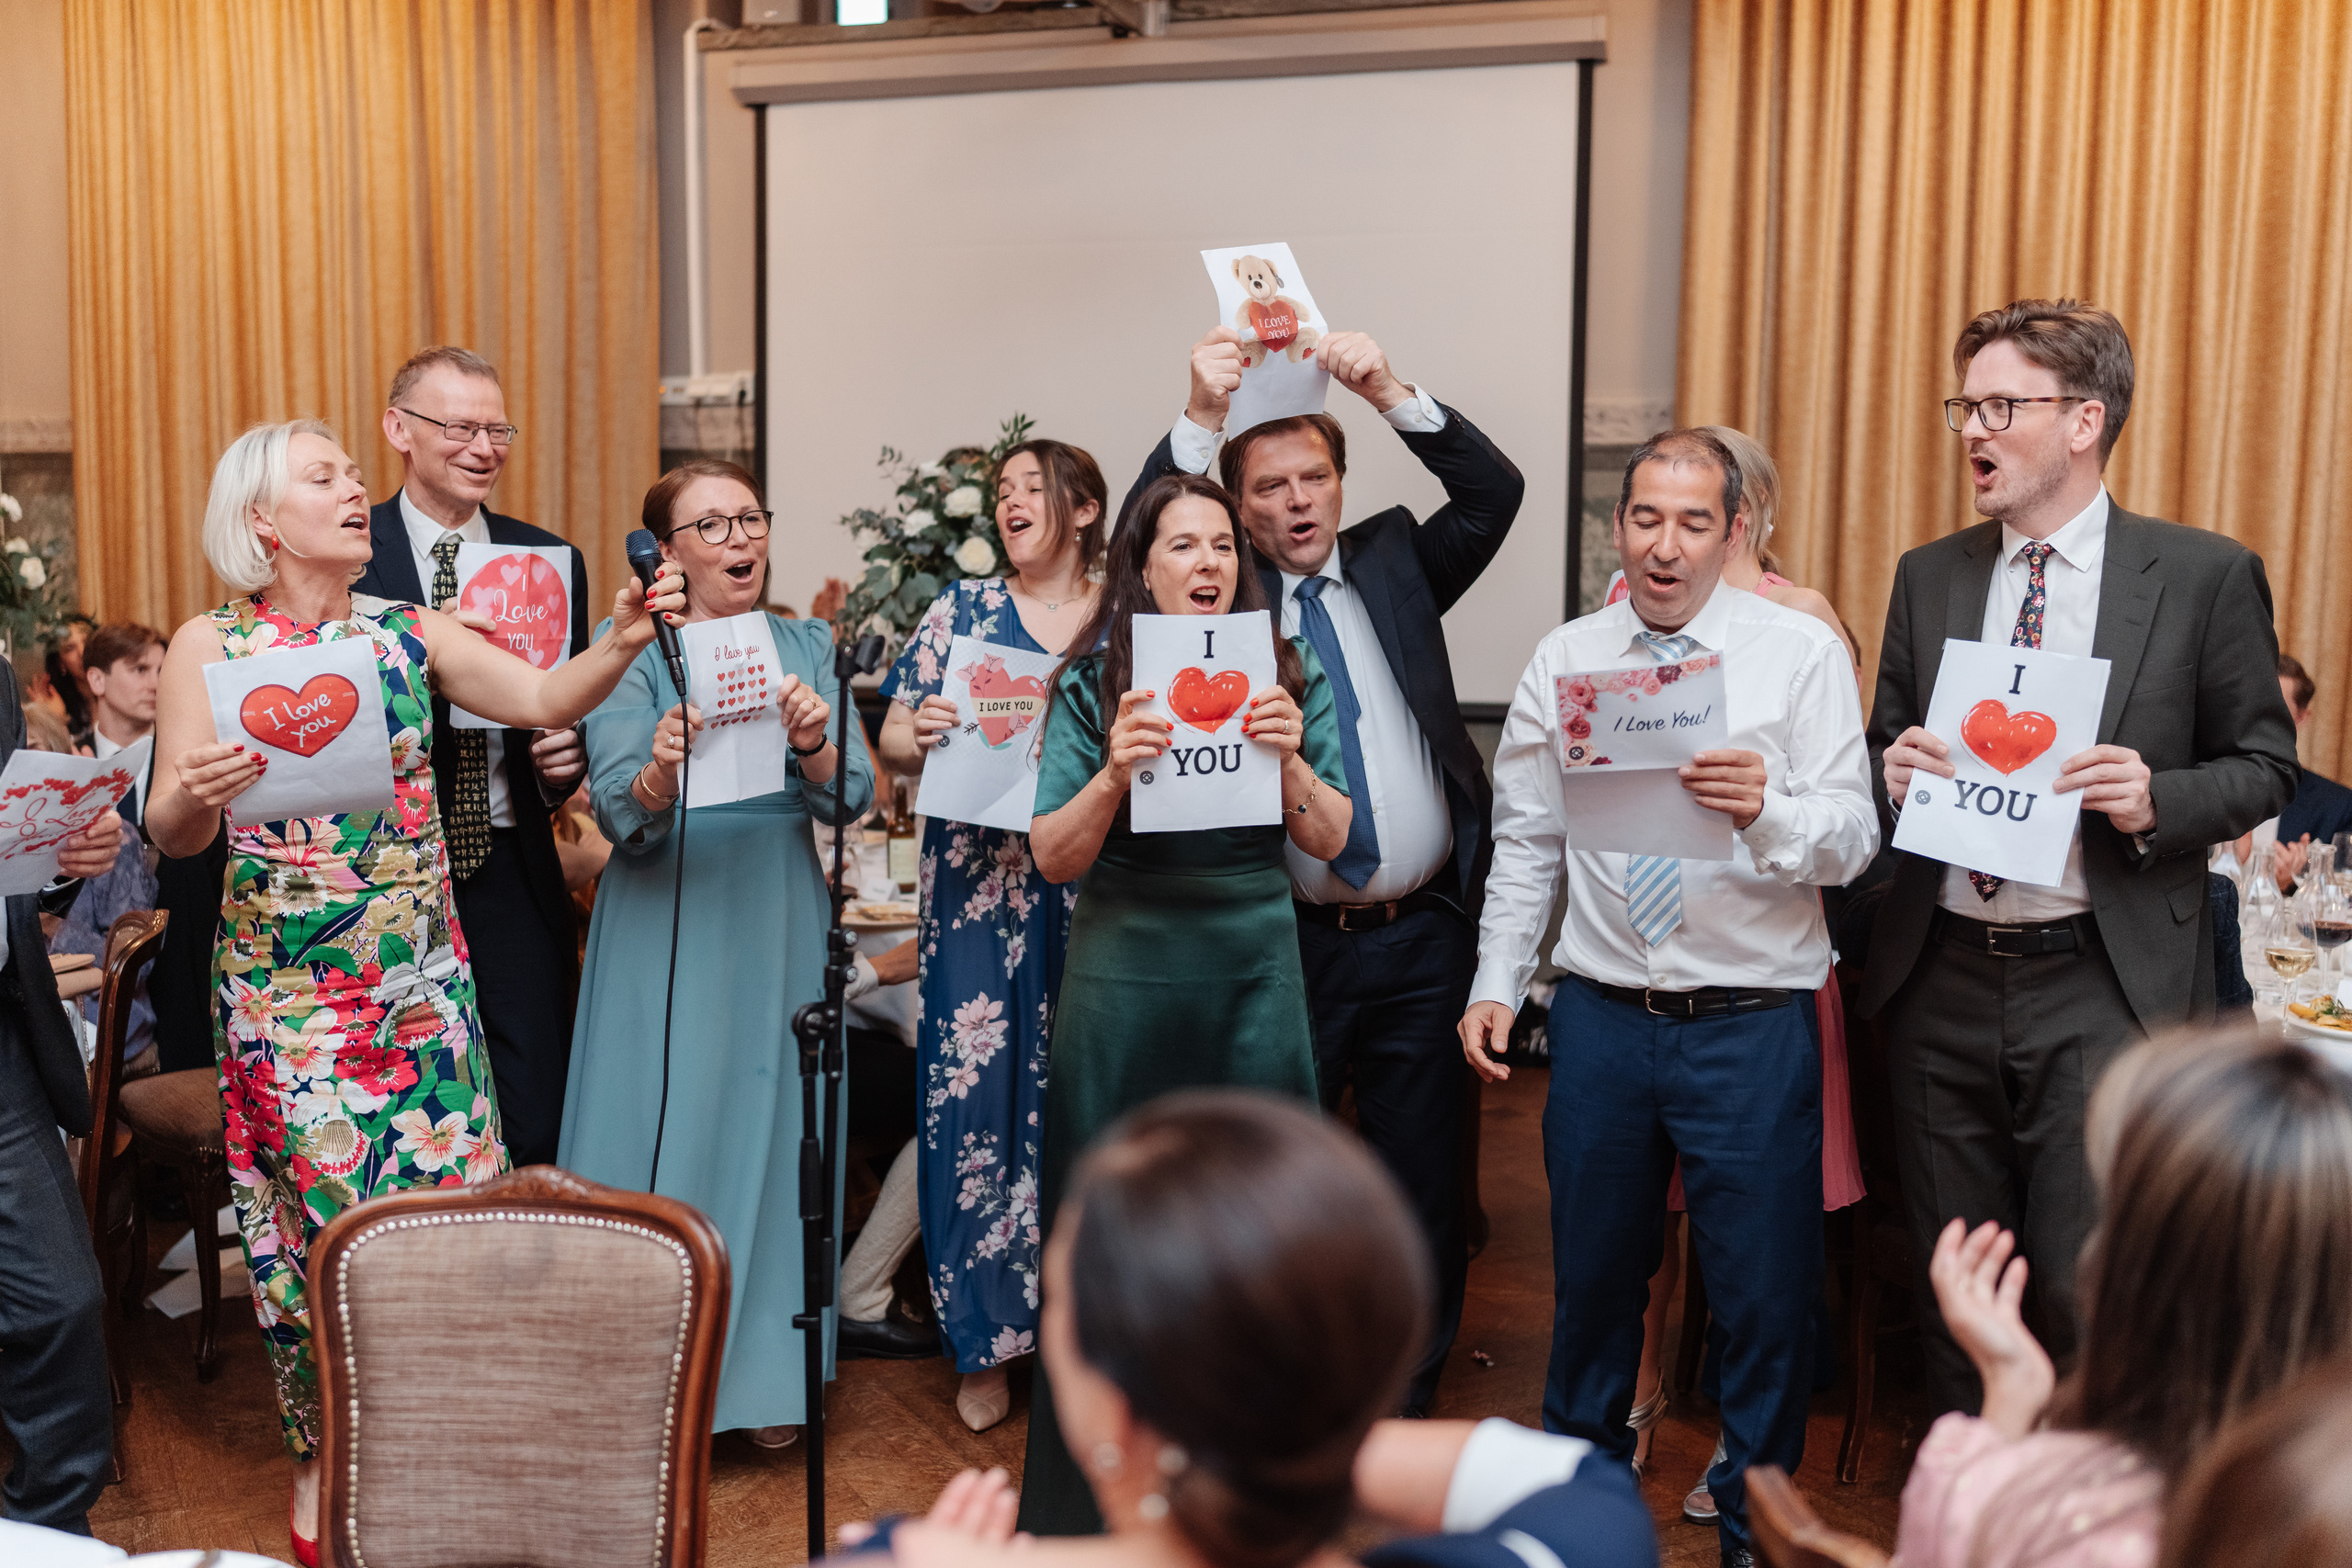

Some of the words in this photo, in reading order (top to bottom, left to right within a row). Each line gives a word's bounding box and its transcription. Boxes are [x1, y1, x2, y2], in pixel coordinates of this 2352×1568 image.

[1259, 318, 1263, 328] I
[1264, 315, 1291, 328] LOVE
[1267, 327, 1290, 339] YOU
[522, 573, 526, 592] I
[493, 589, 548, 624] Love
[507, 632, 534, 651] YOU
[724, 645, 742, 660] love
[744, 645, 760, 660] you
[1204, 630, 1215, 659] I
[2008, 664, 2026, 695] I
[263, 706, 286, 731] I
[282, 694, 332, 721] love
[979, 702, 984, 712] I
[987, 701, 1012, 712] LOVE
[1014, 701, 1033, 710] YOU
[1613, 716, 1623, 732] I
[1625, 716, 1666, 732] Love
[1671, 705, 1711, 729] You!
[1170, 743, 1243, 776] YOU
[1954, 779, 2038, 822] YOU
